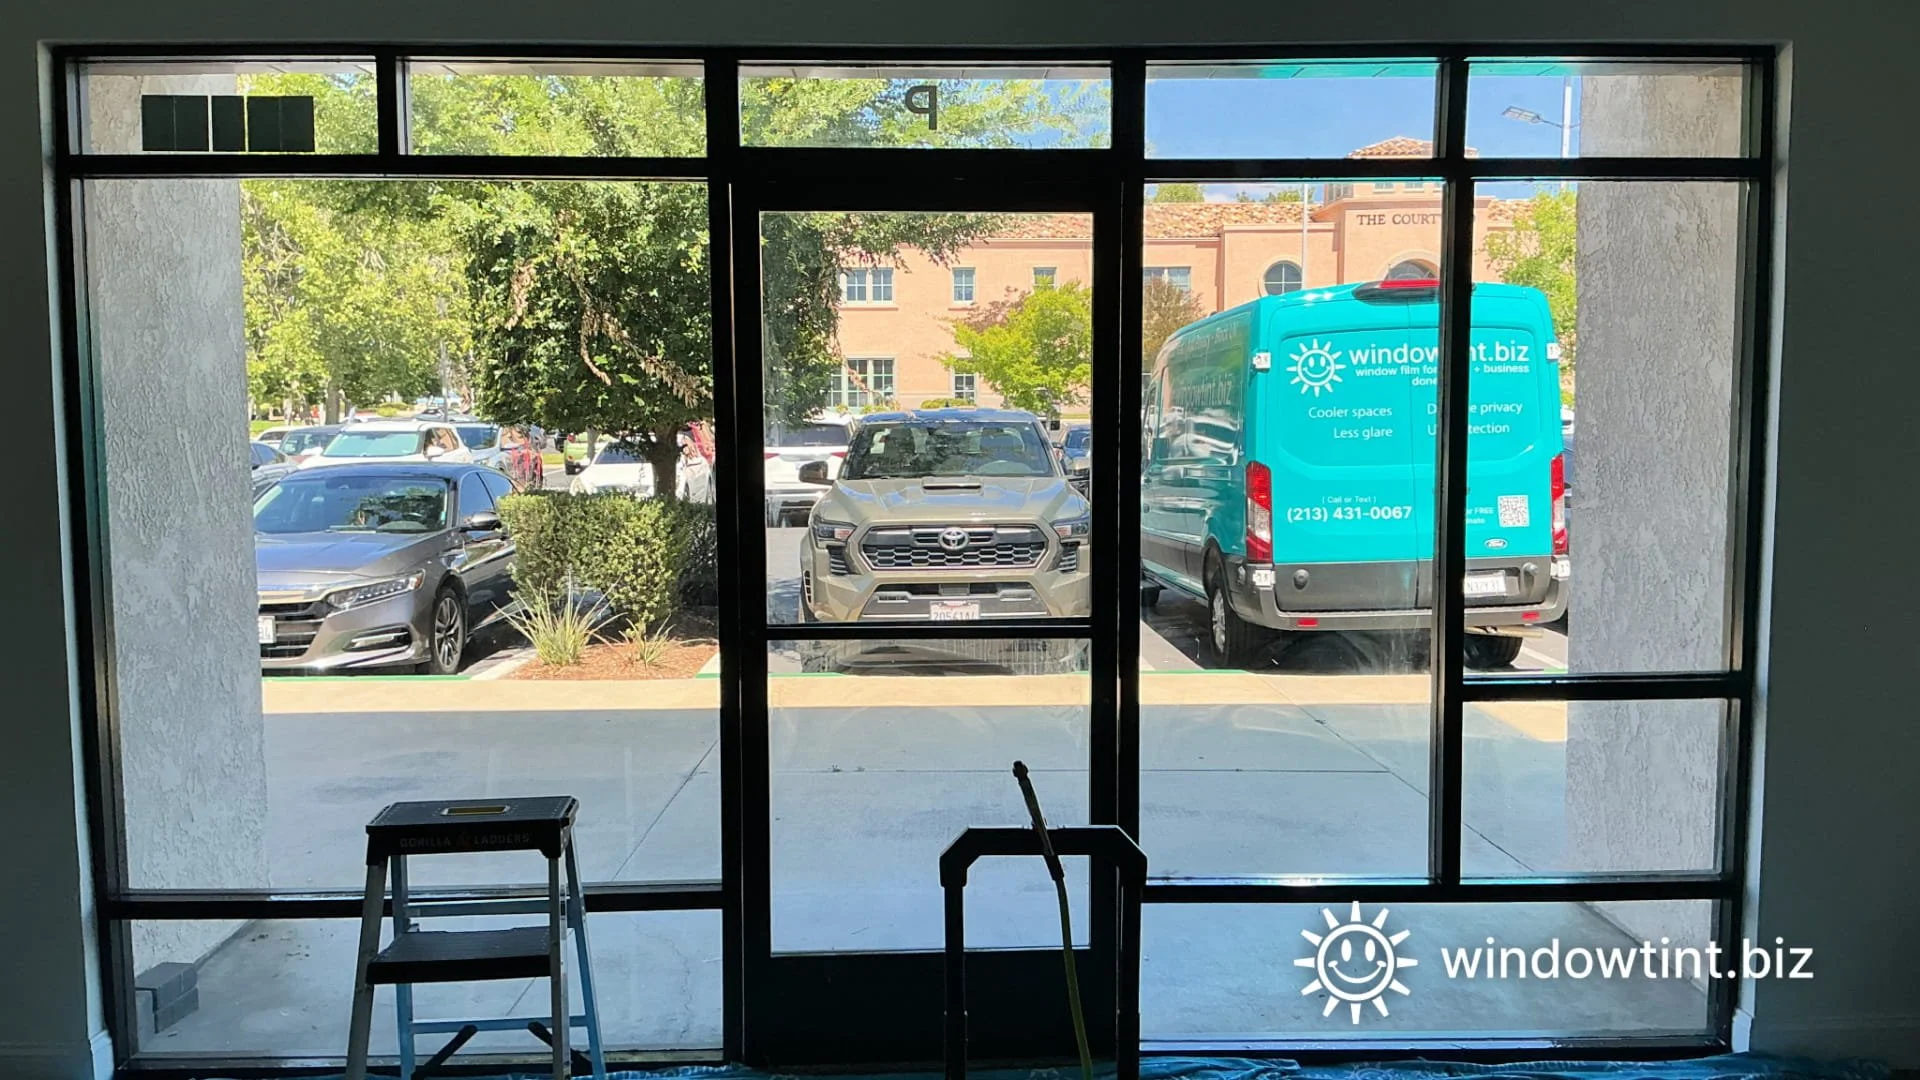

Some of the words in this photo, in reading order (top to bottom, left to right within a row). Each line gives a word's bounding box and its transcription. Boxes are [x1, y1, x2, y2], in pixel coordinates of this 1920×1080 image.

[1356, 214, 1386, 226] THE
[1391, 213, 1441, 225] COURT
[1355, 367, 1398, 377] window
[1400, 364, 1420, 375] film
[1483, 363, 1530, 374] business
[1308, 406, 1349, 419] Cooler
[1351, 407, 1393, 419] spaces
[1480, 402, 1523, 416] privacy
[1333, 427, 1360, 439] Less
[1362, 425, 1393, 441] glare
[1468, 422, 1510, 435] tection
[1287, 507, 1329, 523] (213)
[1332, 506, 1412, 521] 431-0067
[399, 836, 452, 848] GORILLA
[474, 831, 531, 846] LADDERS
